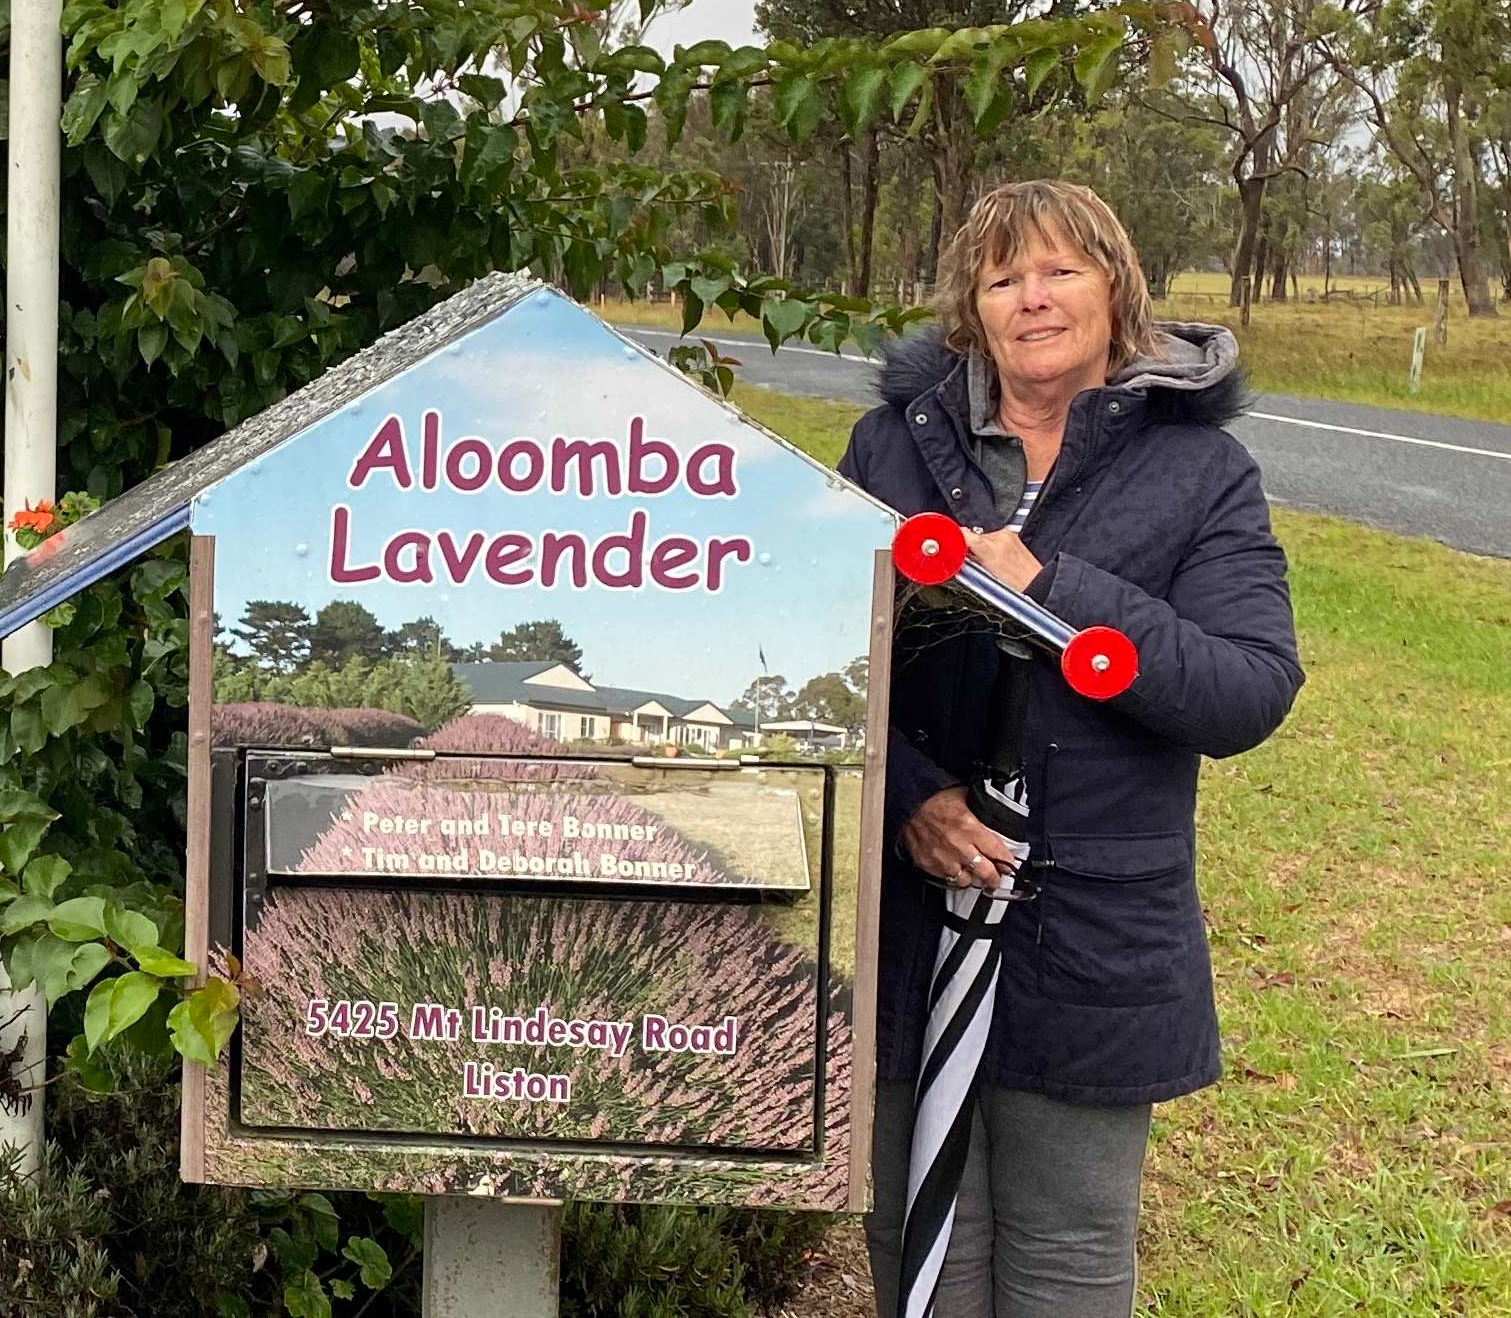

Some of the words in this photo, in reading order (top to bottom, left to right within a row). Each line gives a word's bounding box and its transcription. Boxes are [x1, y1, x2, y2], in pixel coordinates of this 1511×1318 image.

[348, 411, 737, 497] Aloomba
[329, 506, 751, 591] Lavender
[363, 810, 432, 835] Peter
[440, 812, 489, 835] and
[498, 814, 552, 838] Tere
[562, 816, 657, 841] Bonner
[361, 846, 409, 869] Tim
[418, 847, 469, 872] and
[479, 850, 590, 876] Deborah
[600, 854, 696, 880] Bonner
[306, 1001, 399, 1038] 5425
[412, 1003, 460, 1041] Mt
[473, 1007, 632, 1057] Lindesay
[643, 1015, 738, 1054] Road
[464, 1063, 571, 1102] Liston
